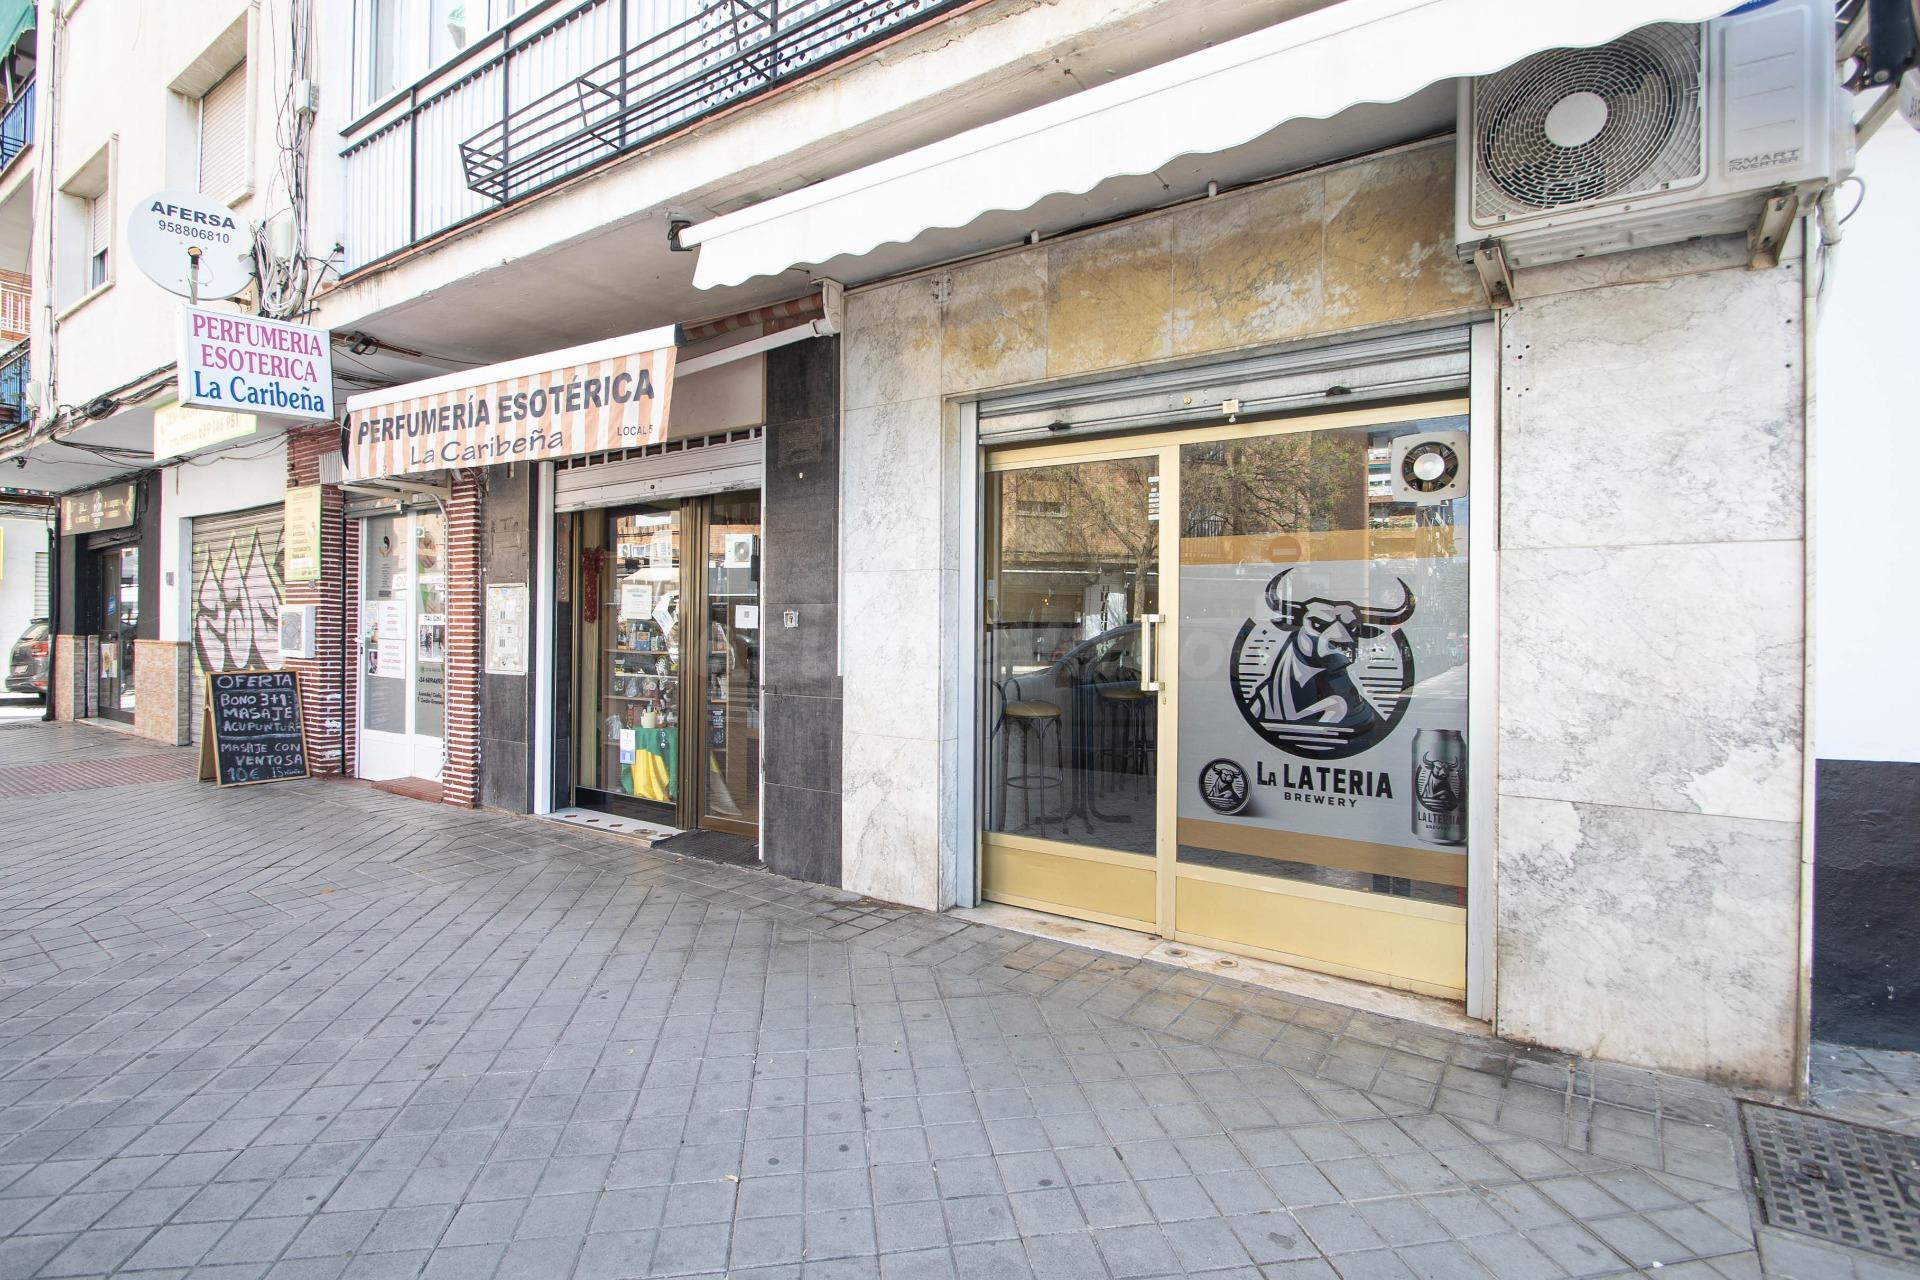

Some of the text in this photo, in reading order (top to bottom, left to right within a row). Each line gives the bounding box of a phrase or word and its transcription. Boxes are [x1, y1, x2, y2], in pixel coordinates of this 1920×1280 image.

[1728, 148, 1799, 166] SMART
[1728, 156, 1799, 173] INVERTER
[150, 201, 236, 230] AFERSA
[158, 219, 230, 244] 958806810
[192, 314, 323, 357] PERFUMERIA
[200, 344, 318, 383] ESOTERICA
[194, 371, 325, 413] La Caribeña
[357, 368, 655, 445] PERFUMERÍA ESOTÉRICA
[617, 426, 647, 437] LOCAL
[410, 428, 564, 466] La Caribeña
[217, 674, 292, 689] OFERTA
[220, 693, 257, 707] BONO
[223, 706, 292, 721] MASAJE
[221, 742, 301, 754] MASAJE CON
[235, 754, 303, 766] VENTOSA
[1283, 763, 1394, 800] LATERIA
[1284, 791, 1358, 808] BREWERY
